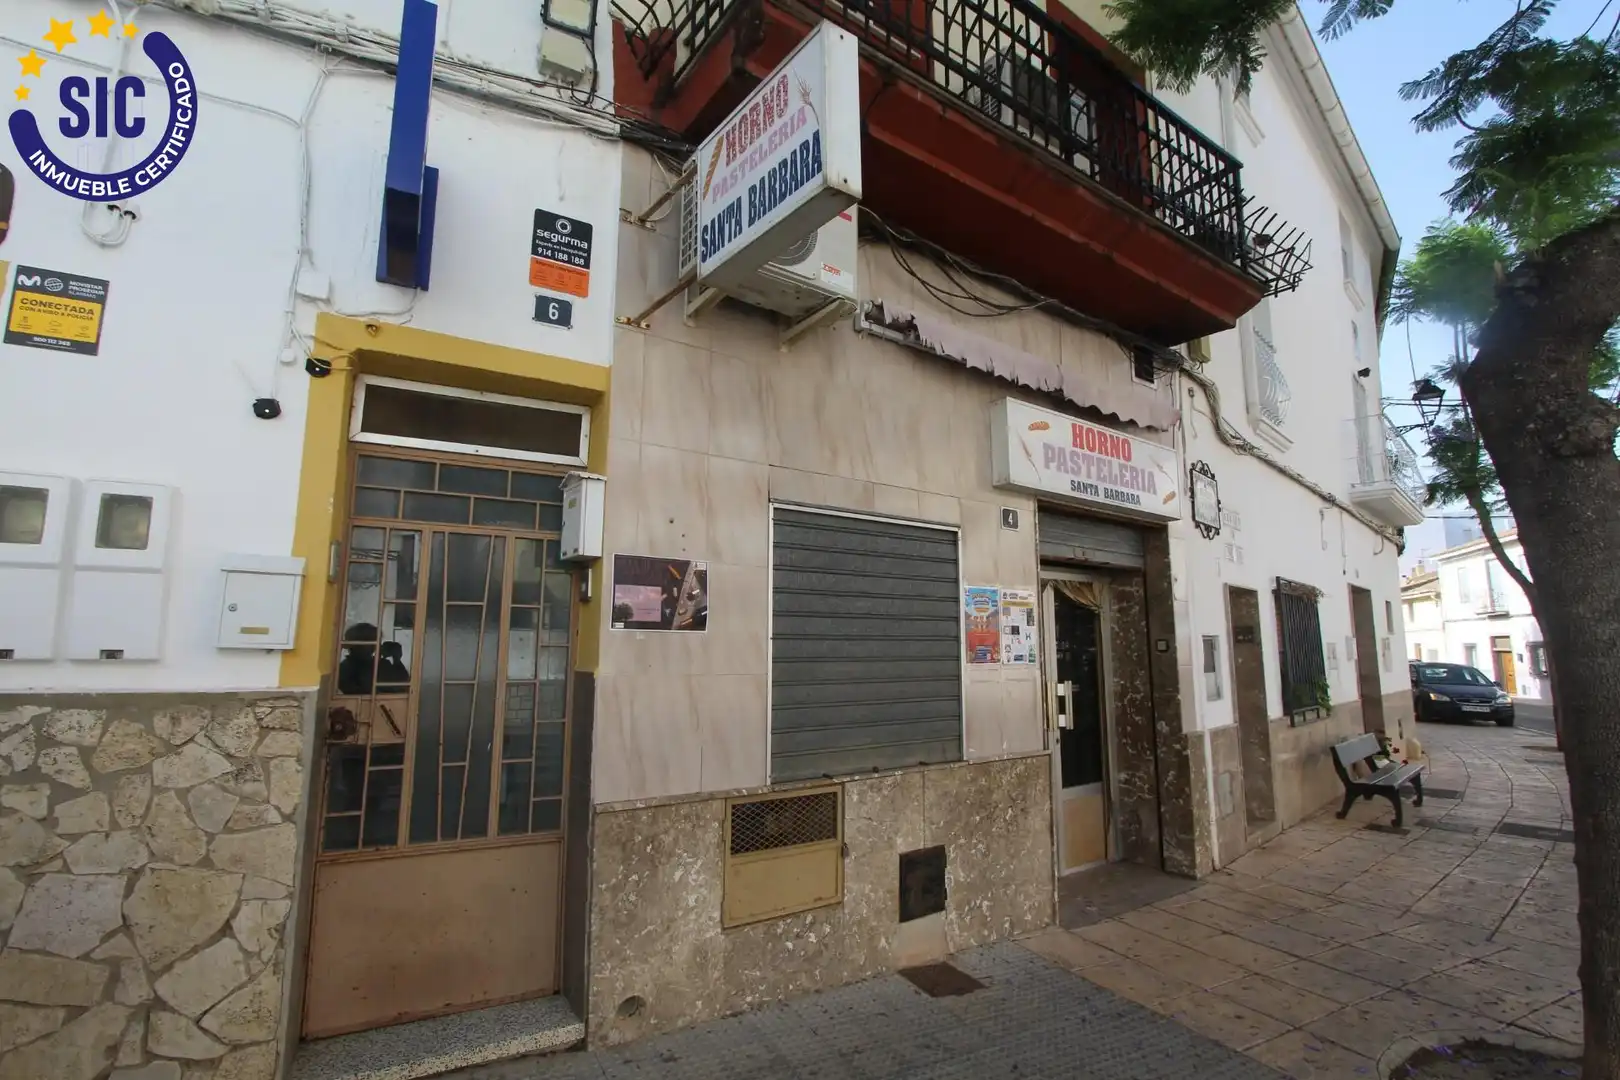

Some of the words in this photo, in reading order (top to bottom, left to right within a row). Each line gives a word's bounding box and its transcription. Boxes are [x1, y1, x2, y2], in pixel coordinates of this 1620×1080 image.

[724, 73, 789, 167] HORNO
[712, 106, 808, 205] PASTELERIA
[701, 195, 743, 264] SANTA
[747, 128, 823, 228] BARBARA
[536, 229, 588, 249] segurma
[537, 247, 551, 256] 914
[554, 251, 568, 261] 188
[571, 256, 585, 265] 188
[20, 298, 95, 315] CONECTADA
[548, 302, 559, 320] 6
[1071, 423, 1132, 462] HORNO
[1042, 442, 1157, 496] PASTELERIA
[1070, 480, 1099, 497] SANTA
[1103, 487, 1141, 506] BARBARA
[1007, 512, 1013, 525] 4
